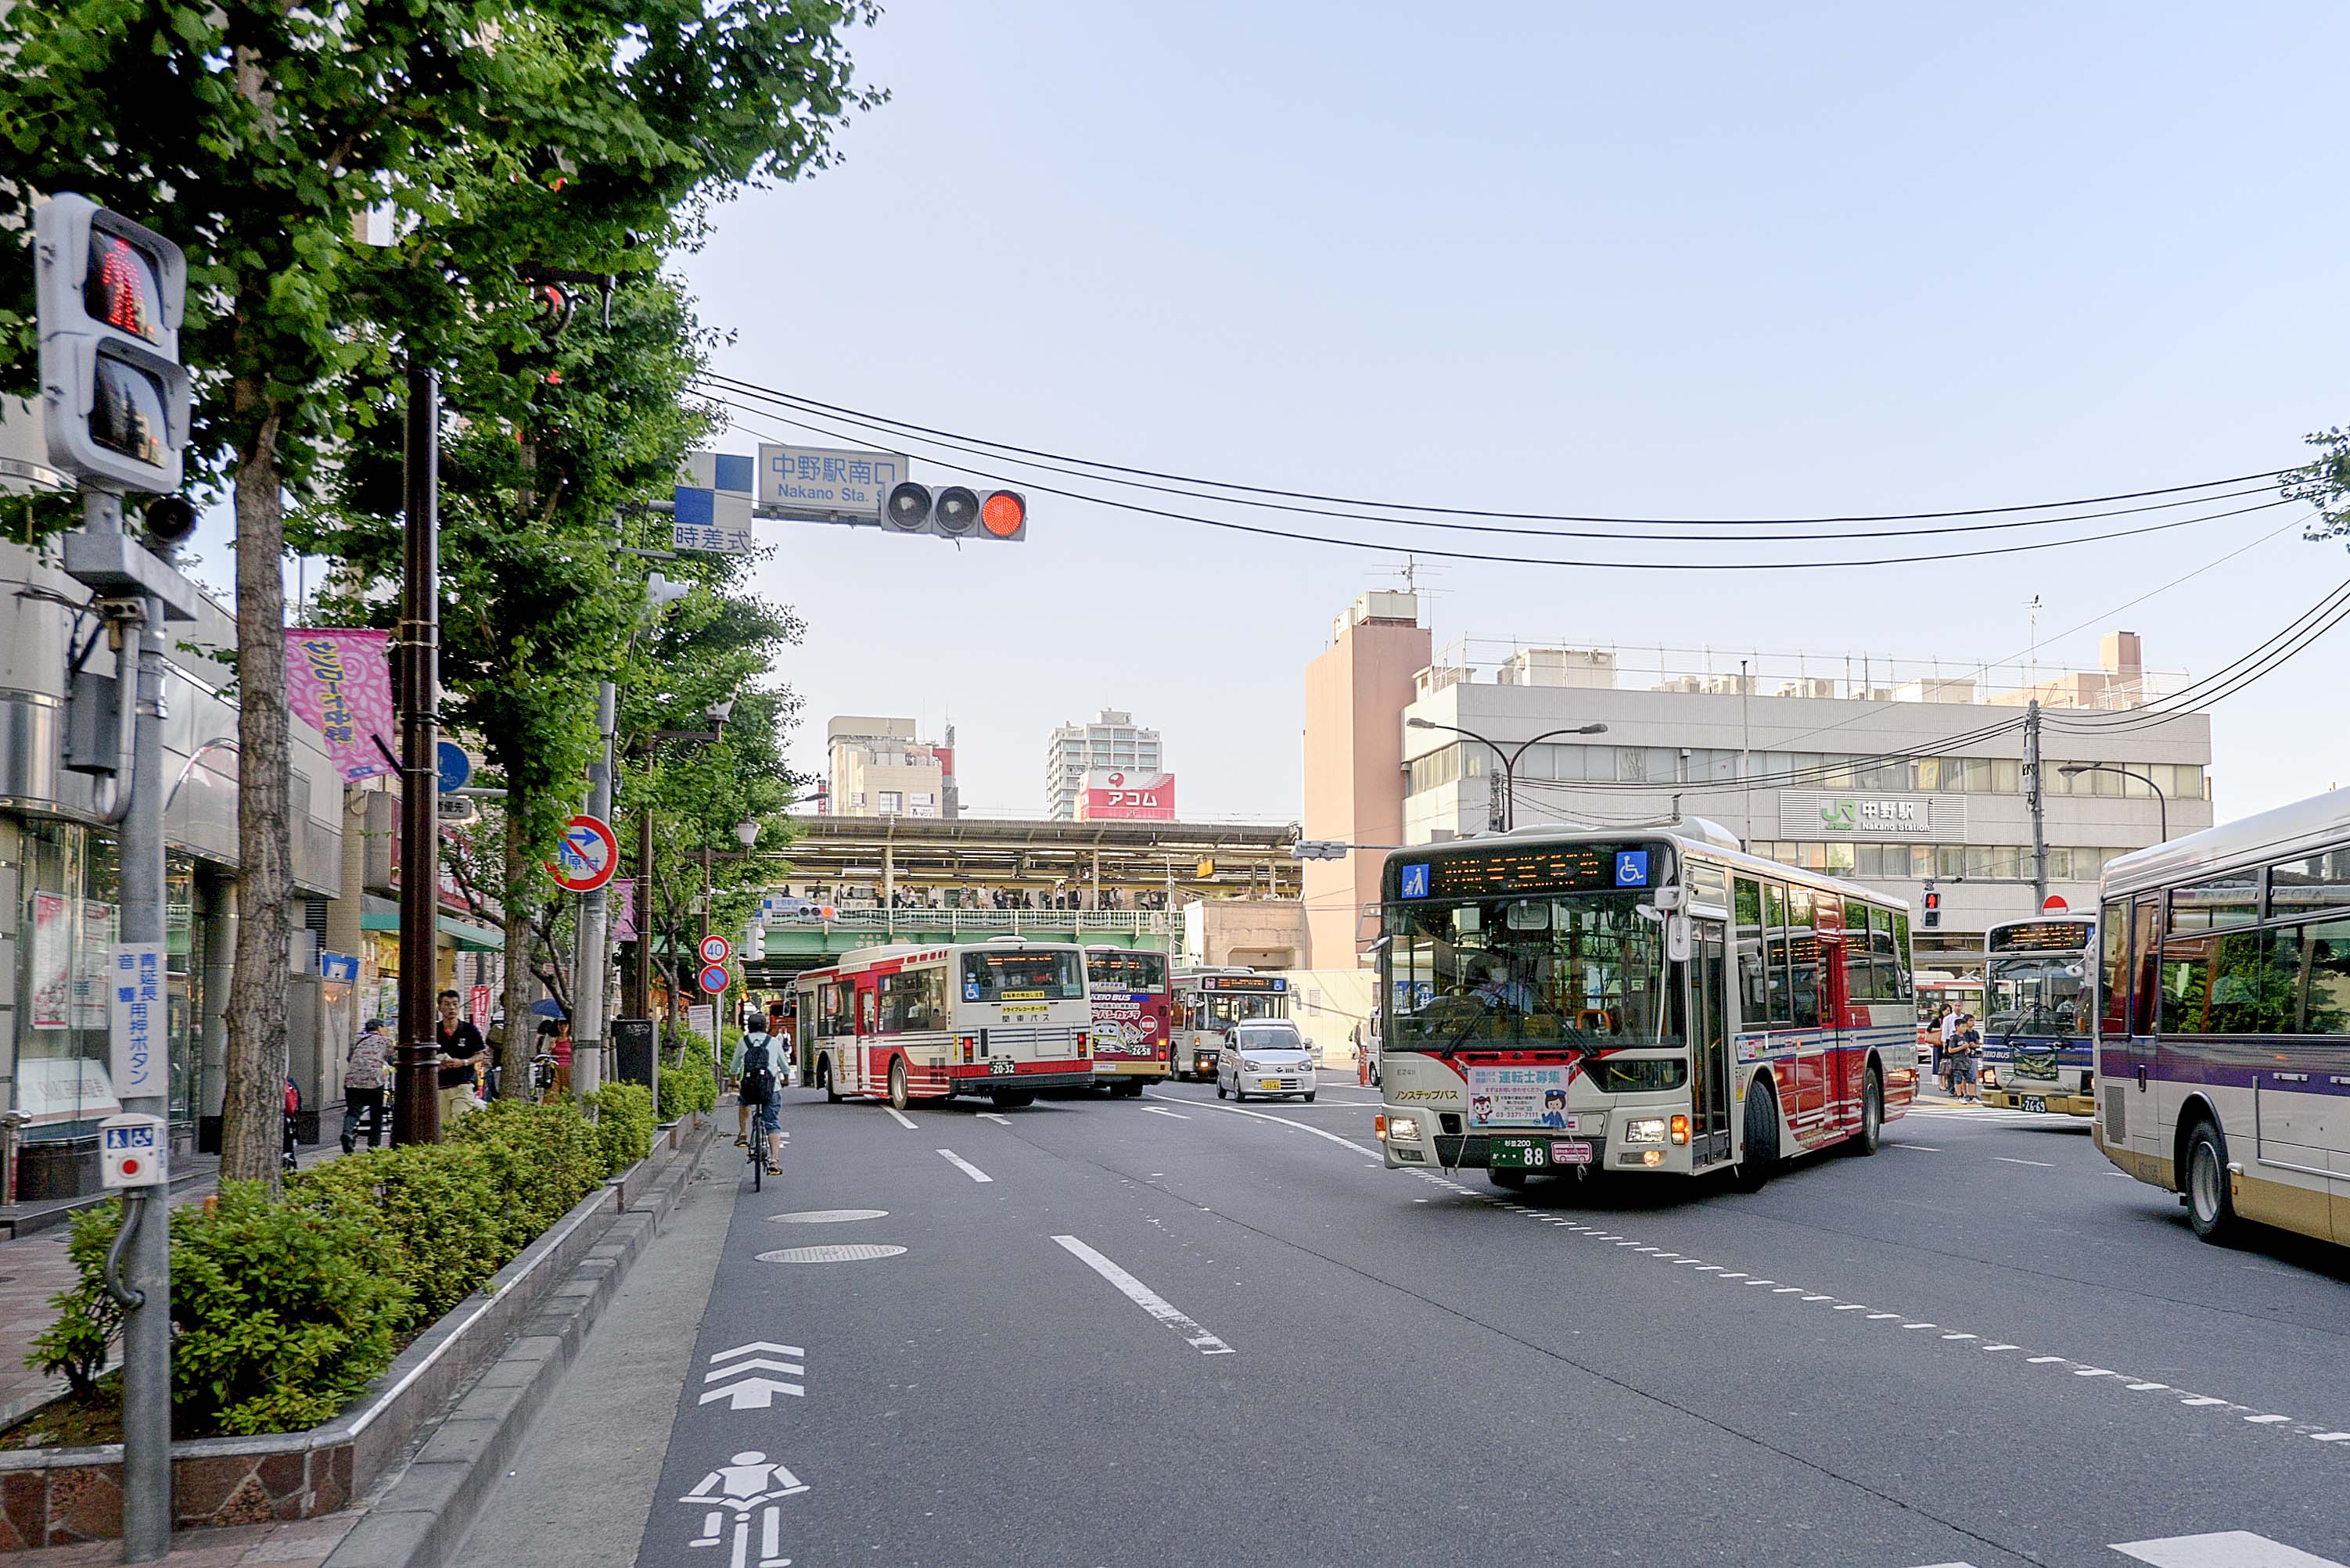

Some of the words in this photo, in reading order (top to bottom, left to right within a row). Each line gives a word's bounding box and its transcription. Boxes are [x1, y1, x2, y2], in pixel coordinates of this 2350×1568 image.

[772, 454, 895, 485] 中野駅南口
[778, 483, 834, 501] Nakano
[841, 487, 869, 503] Sta.
[676, 526, 749, 552] 時差式
[1108, 791, 1158, 807] アコム
[1822, 799, 1856, 821] JR
[1862, 801, 1914, 820] 中野駅
[1862, 822, 1895, 831] Nakano
[1898, 823, 1930, 831] Station
[706, 944, 723, 956] 40
[139, 953, 159, 1002] 青延長
[129, 1003, 149, 1085] 用押ボタン
[993, 1064, 1015, 1074] 20-32
[1498, 1070, 1561, 1084] 運転士募集
[1395, 1090, 1459, 1100] ノンステップバス
[2025, 1100, 2046, 1112] 26-69
